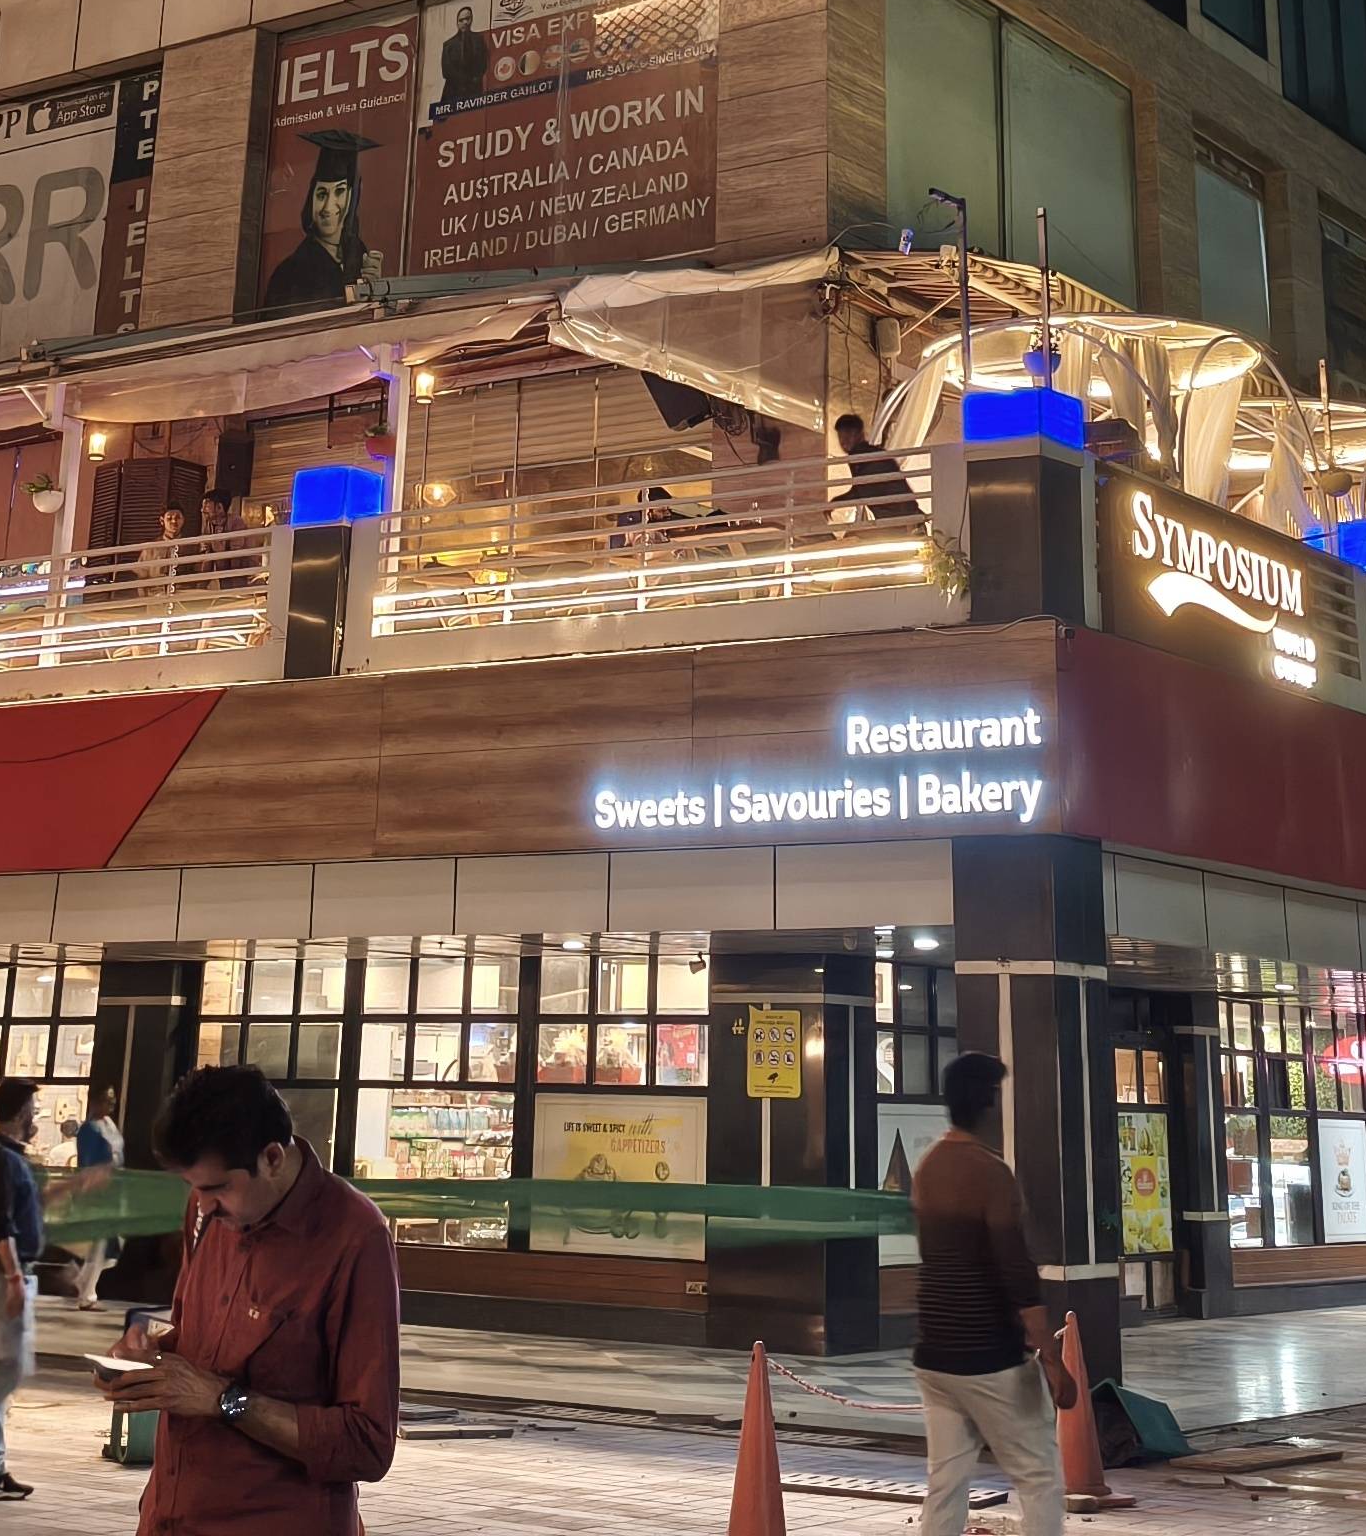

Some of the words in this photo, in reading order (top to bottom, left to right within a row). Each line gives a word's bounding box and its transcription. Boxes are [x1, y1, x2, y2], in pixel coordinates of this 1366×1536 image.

[491, 22, 541, 49] VISA
[277, 33, 409, 106] IELTS
[56, 107, 78, 124] App
[79, 101, 107, 118] Store
[137, 79, 160, 160] PTE
[274, 109, 324, 127] Admission
[326, 106, 334, 117] &
[336, 102, 357, 115] Visa
[435, 104, 453, 116] MR.
[455, 90, 508, 111] RAVINDER
[437, 122, 534, 168] STUDY
[541, 117, 561, 146] &
[570, 94, 666, 140] WORK
[675, 85, 704, 118] IN
[441, 214, 468, 237] UK
[484, 205, 523, 229] USA
[539, 190, 586, 218] NEW
[590, 171, 689, 208] ZEALAND
[443, 160, 570, 206] AUSTRALIA
[588, 136, 689, 175] CANADA
[424, 235, 509, 269] IRELAND
[525, 219, 587, 251] DUBAI
[604, 196, 711, 234] GERMANY
[1132, 490, 1305, 617] SYMPOSIUM
[846, 707, 1043, 756] Restaurant
[594, 790, 706, 829] Sweets
[729, 778, 892, 824] Savouries
[918, 770, 1043, 823] Bakery
